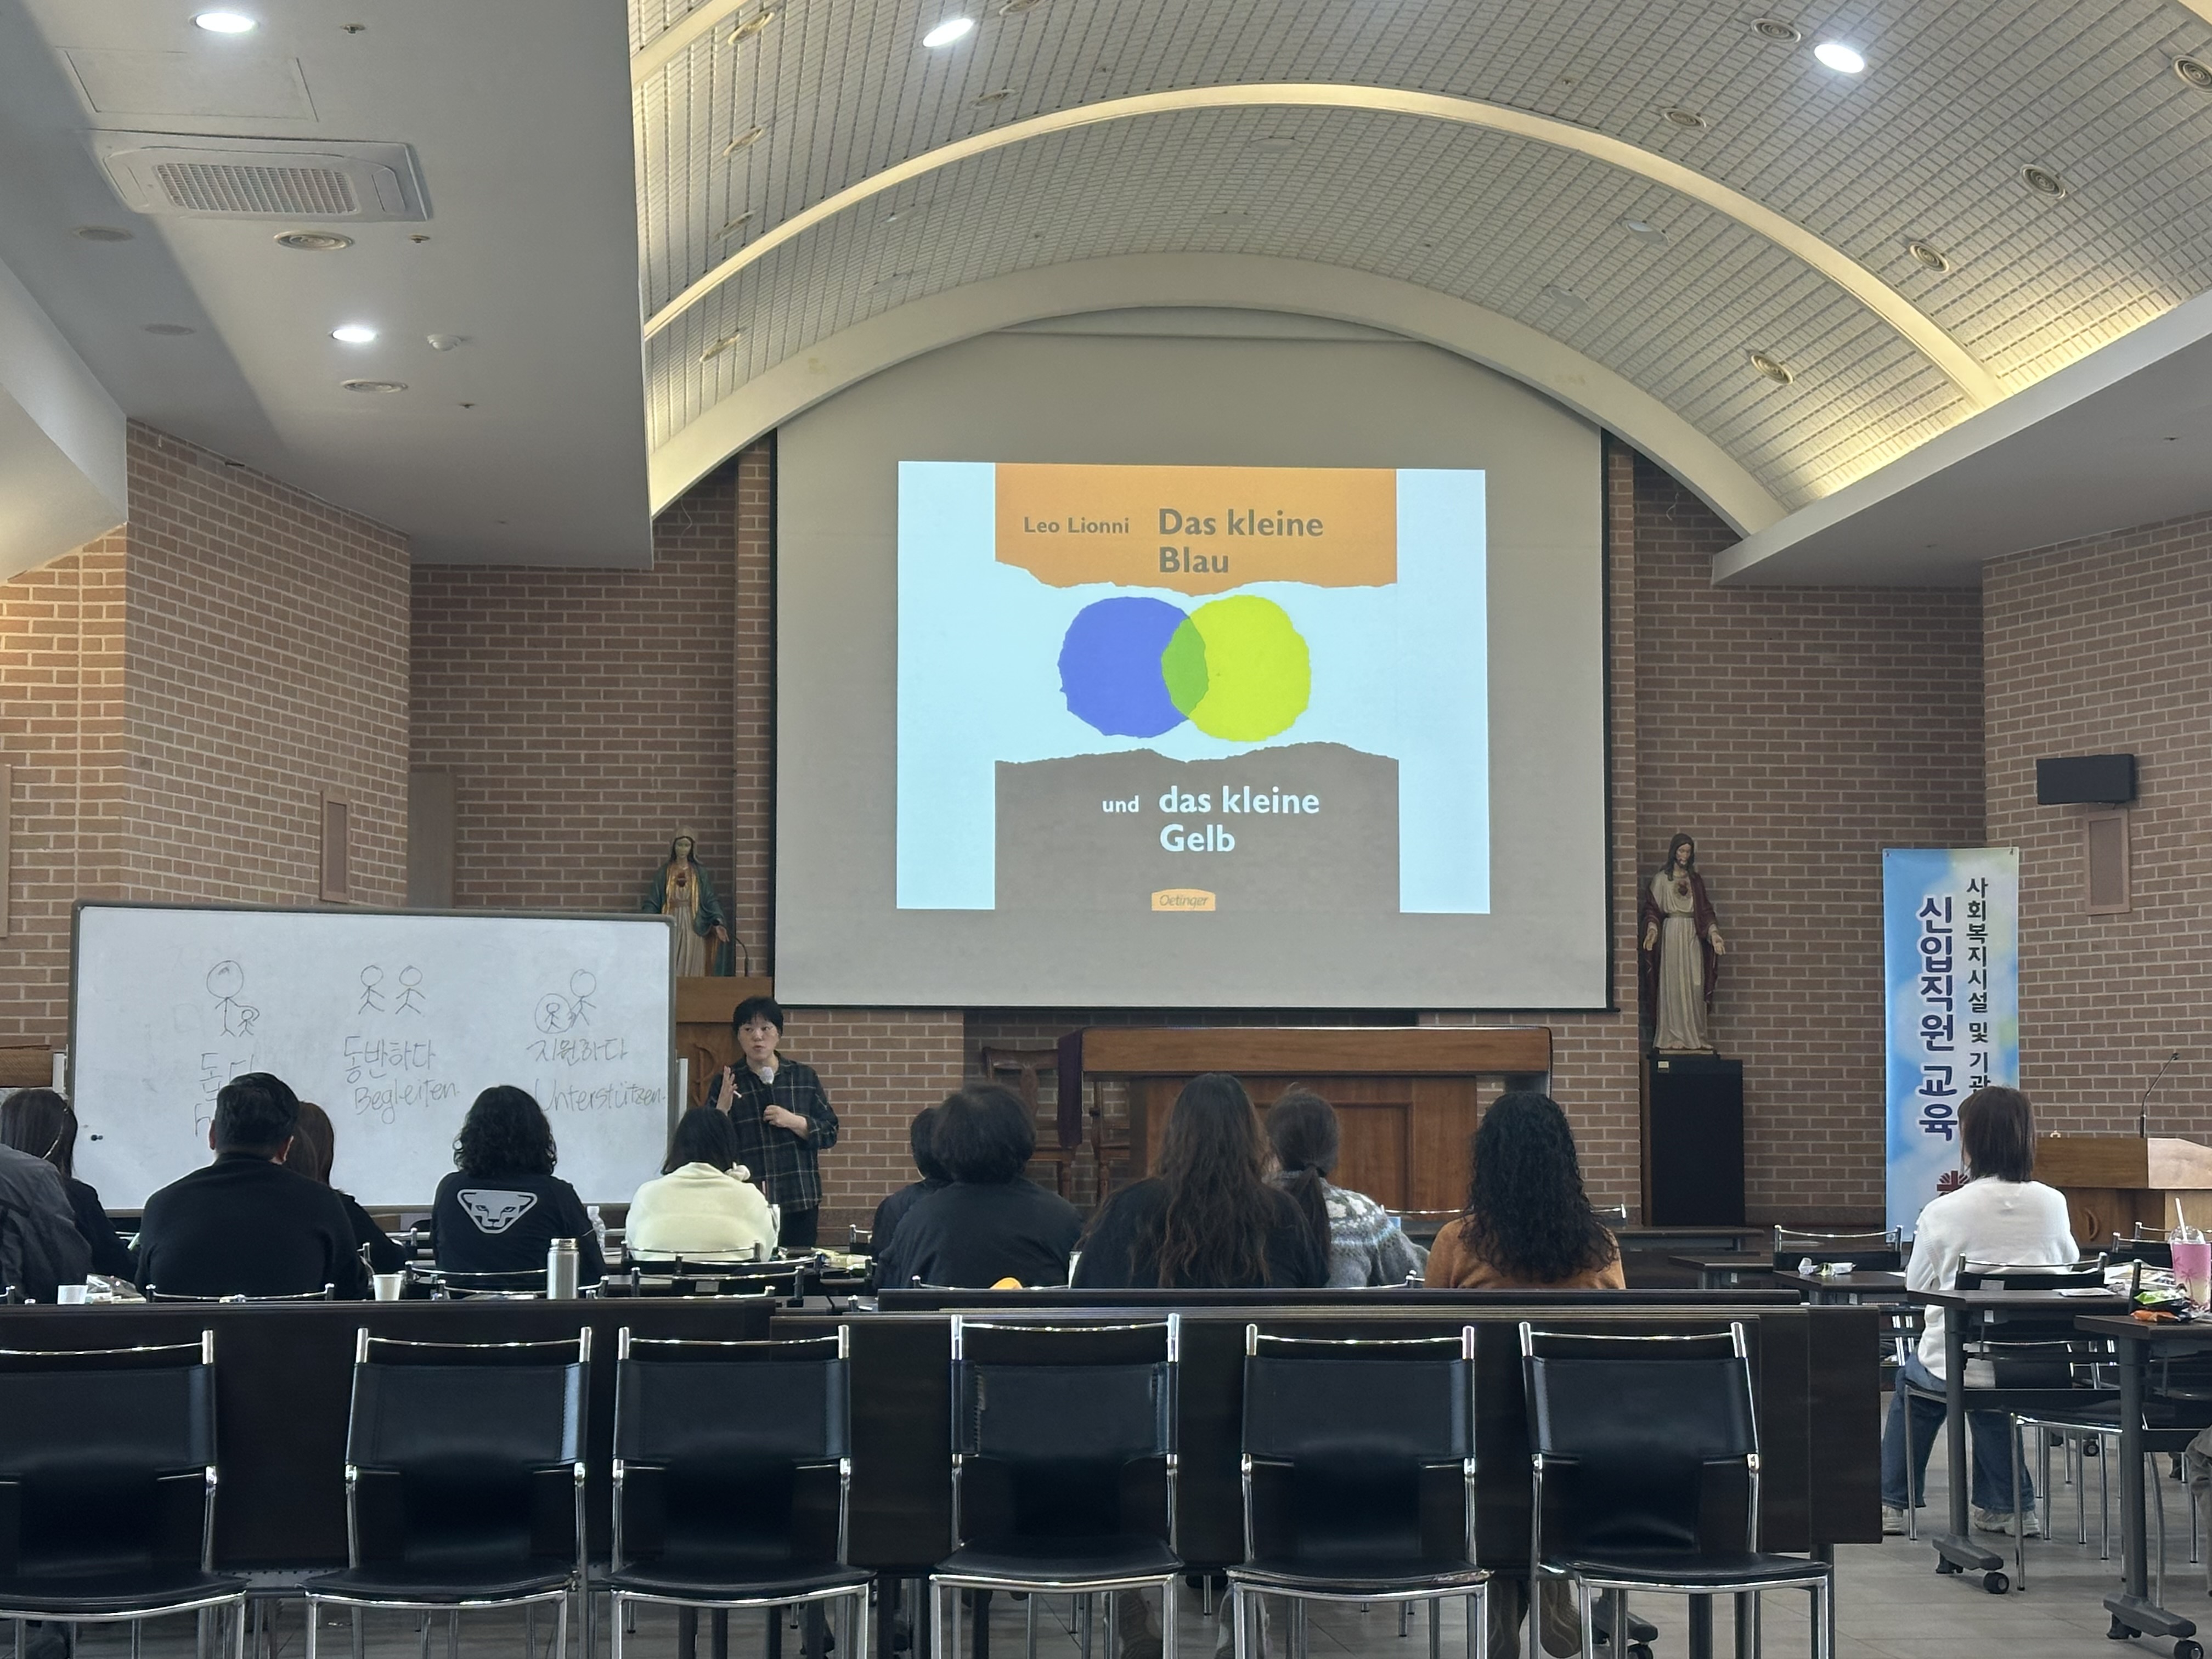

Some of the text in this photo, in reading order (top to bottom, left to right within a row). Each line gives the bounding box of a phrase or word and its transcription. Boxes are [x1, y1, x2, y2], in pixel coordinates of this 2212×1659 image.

[1024, 516, 1130, 534] Leo Lionni
[1159, 508, 1323, 537] Das kleine
[1159, 546, 1229, 573] Blau
[1102, 785, 1321, 814] und das kleine
[1159, 823, 1235, 852] Gelb
[1159, 894, 1209, 909] Oetinger
[1966, 877, 1988, 1014] 사회복지시설
[1918, 896, 1957, 1142] 신입직원 교육
[1968, 1022, 1988, 1043] 및
[343, 1035, 436, 1084] 동반하다
[526, 1038, 628, 1066] 지원하다
